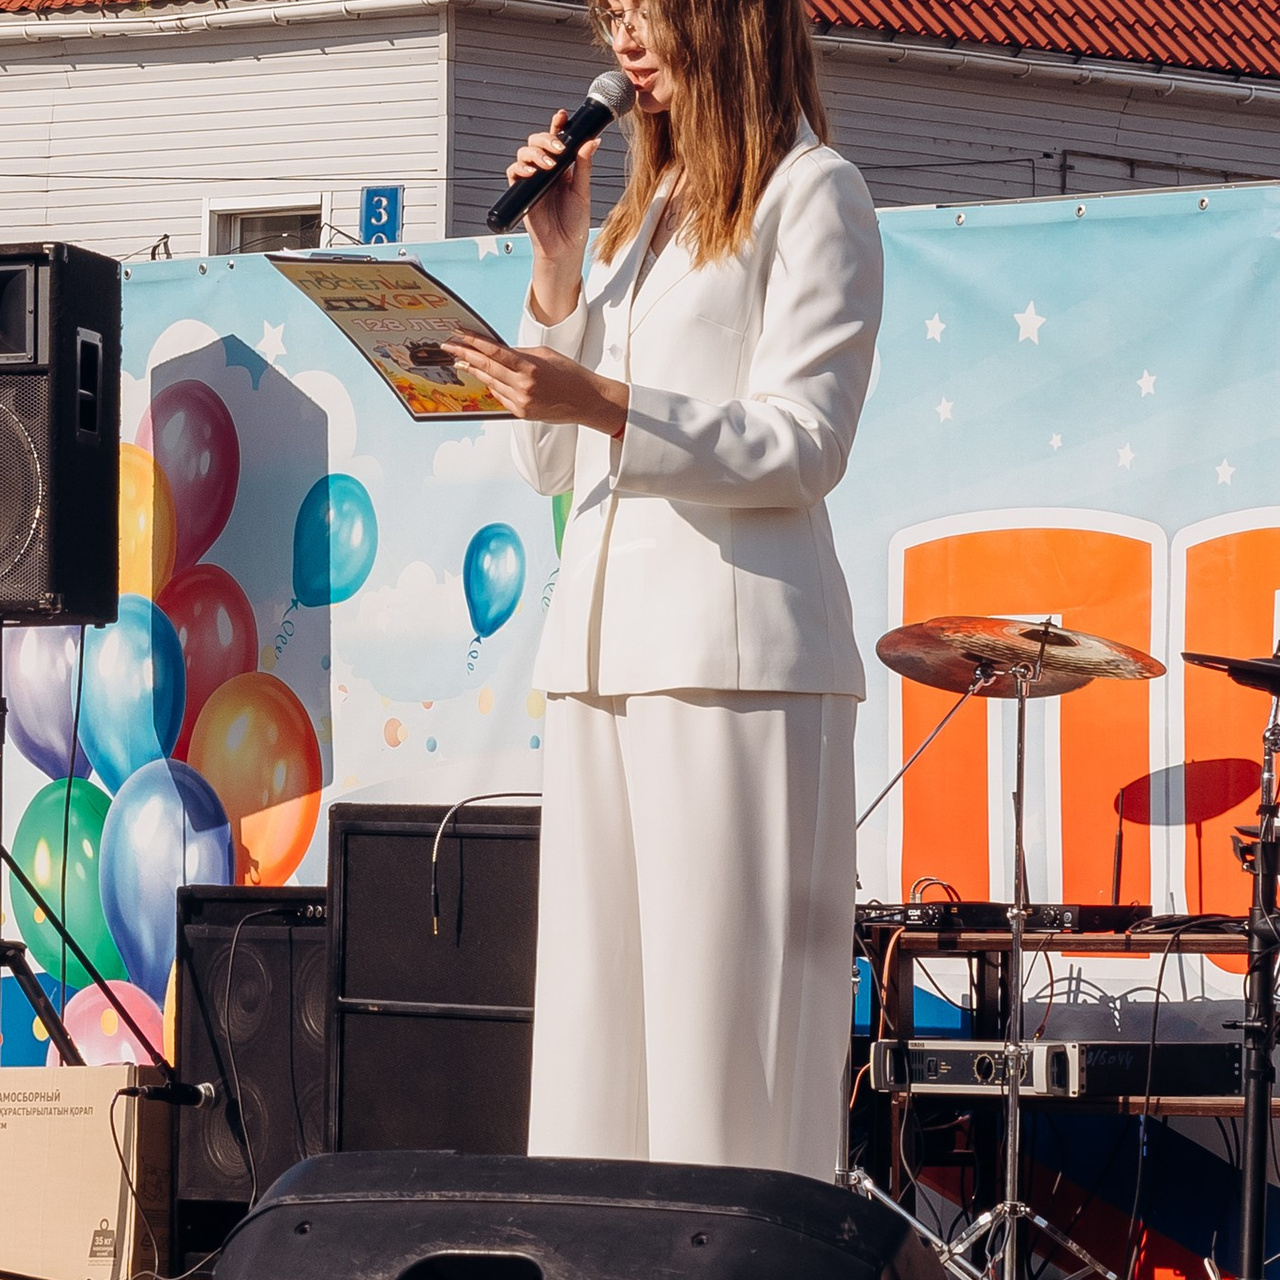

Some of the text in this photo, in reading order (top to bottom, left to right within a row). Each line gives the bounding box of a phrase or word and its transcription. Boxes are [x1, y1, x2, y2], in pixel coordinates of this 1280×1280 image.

[353, 317, 463, 332] 128 ЛЕТ
[69, 1106, 94, 1117] ҚОРАП
[94, 1237, 104, 1246] 35
